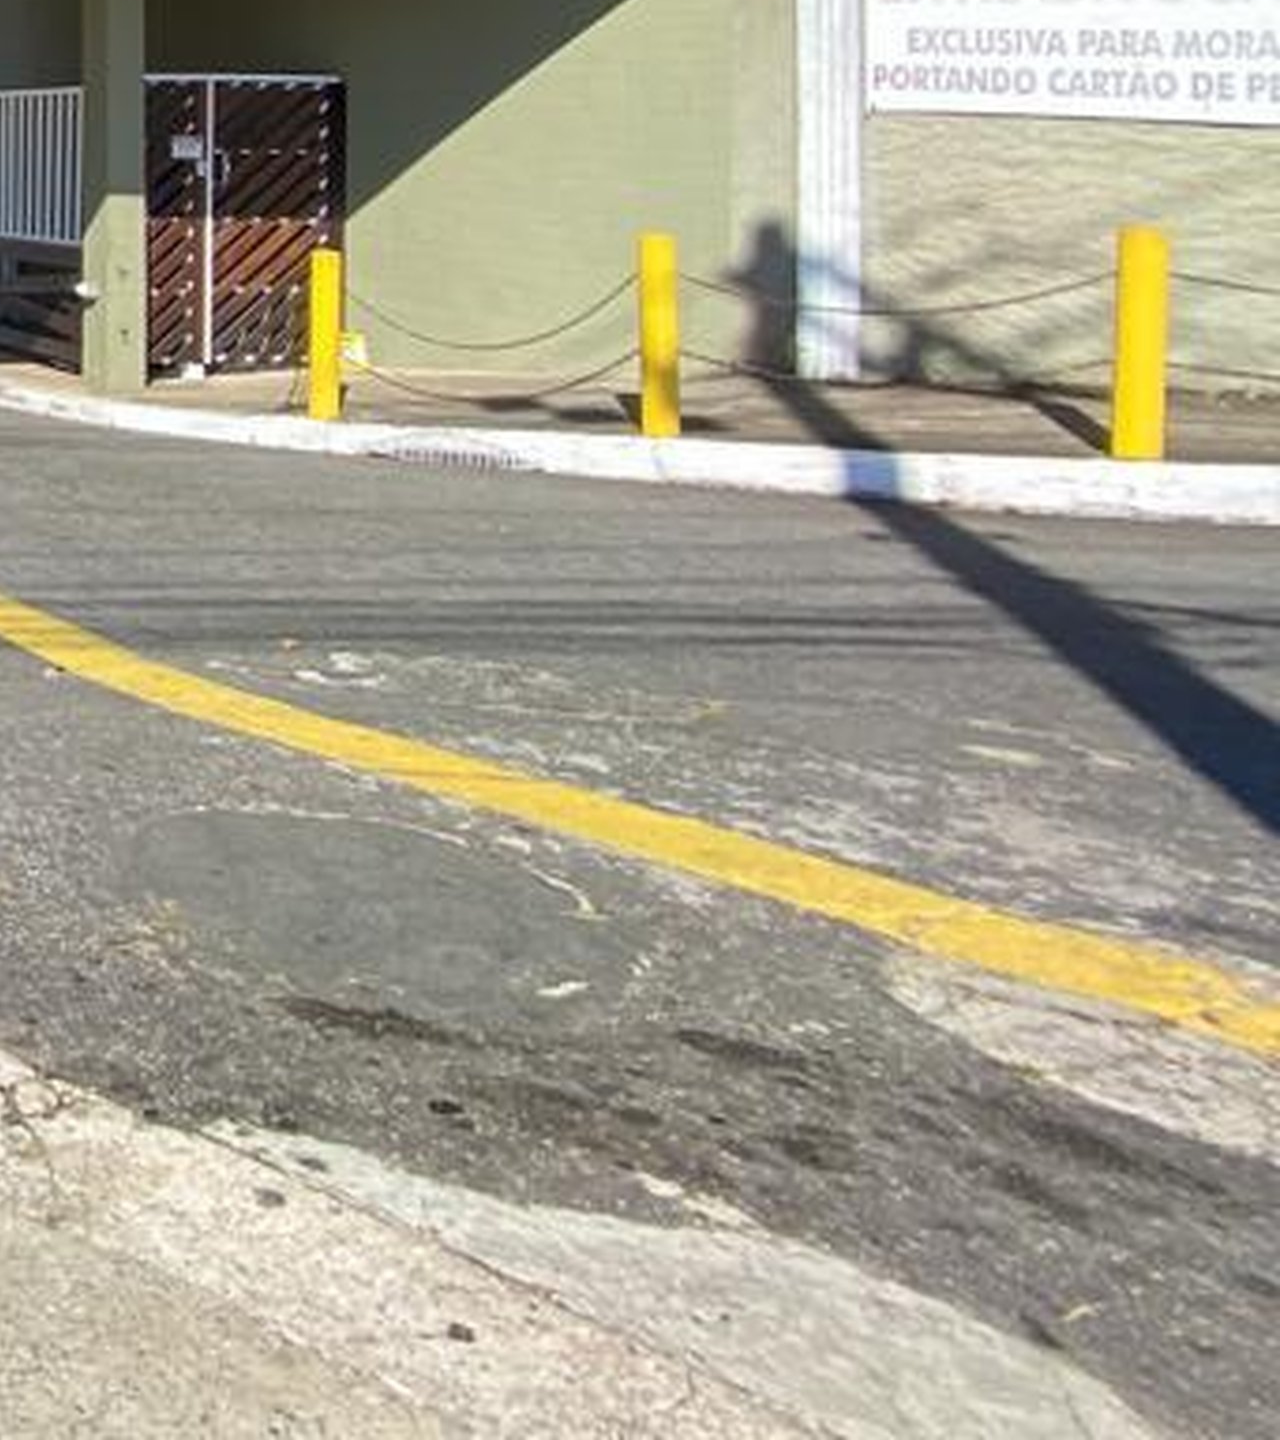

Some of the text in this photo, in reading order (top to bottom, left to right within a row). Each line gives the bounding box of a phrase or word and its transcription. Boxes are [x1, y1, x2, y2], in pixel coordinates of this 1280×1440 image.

[906, 26, 1280, 61] EXCLUSIVA PARA MORA
[872, 63, 1038, 95] PORTANDO
[1191, 69, 1237, 102] DE
